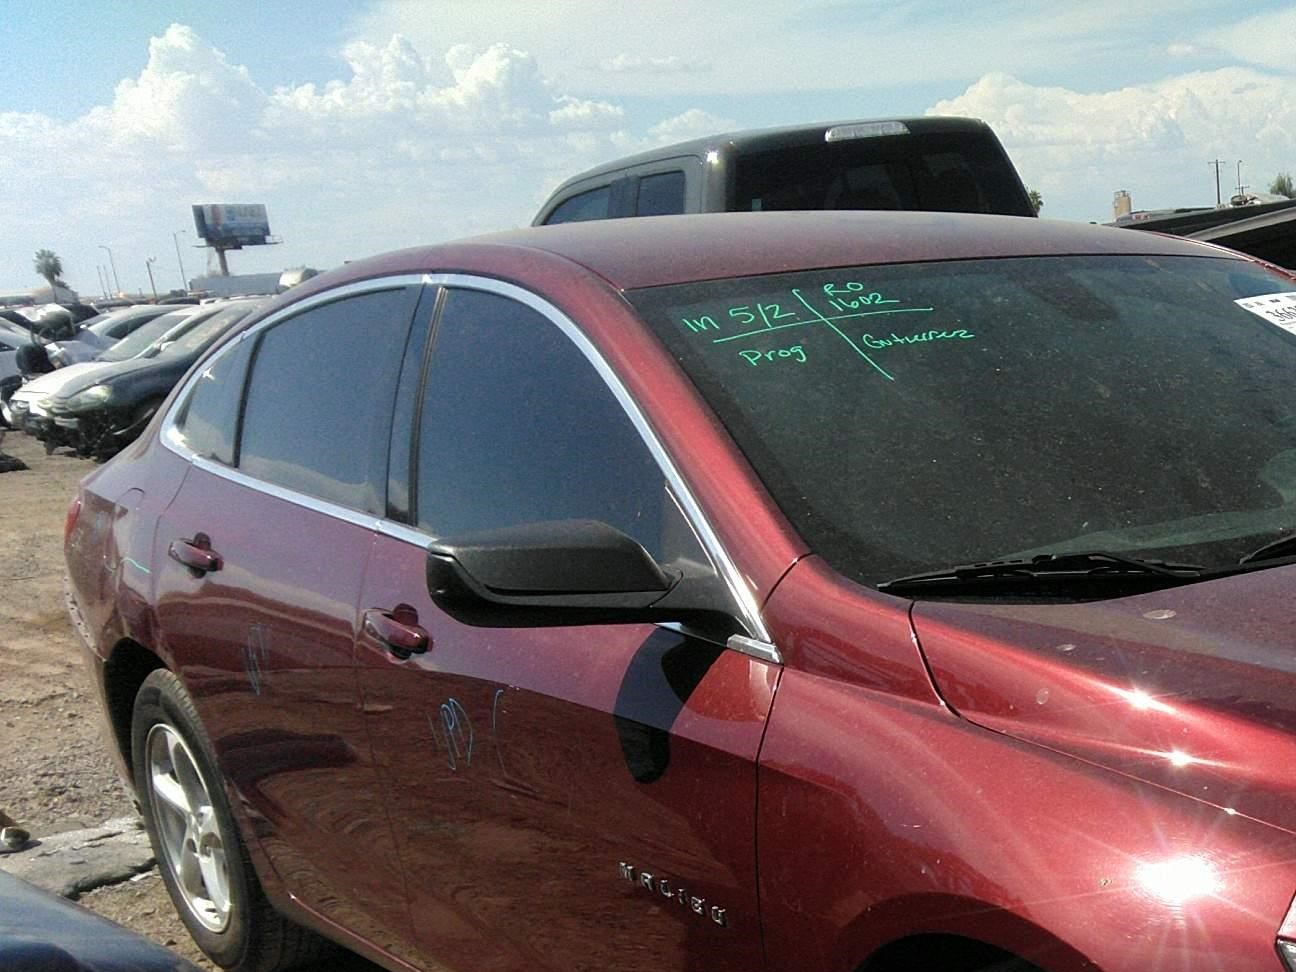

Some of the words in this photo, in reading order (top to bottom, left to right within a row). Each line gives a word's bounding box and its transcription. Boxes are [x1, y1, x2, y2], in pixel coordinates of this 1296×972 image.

[828, 292, 901, 312] 1602
[728, 302, 796, 329] 5/2
[738, 344, 808, 366] Prog
[618, 862, 728, 926] MALIBU
